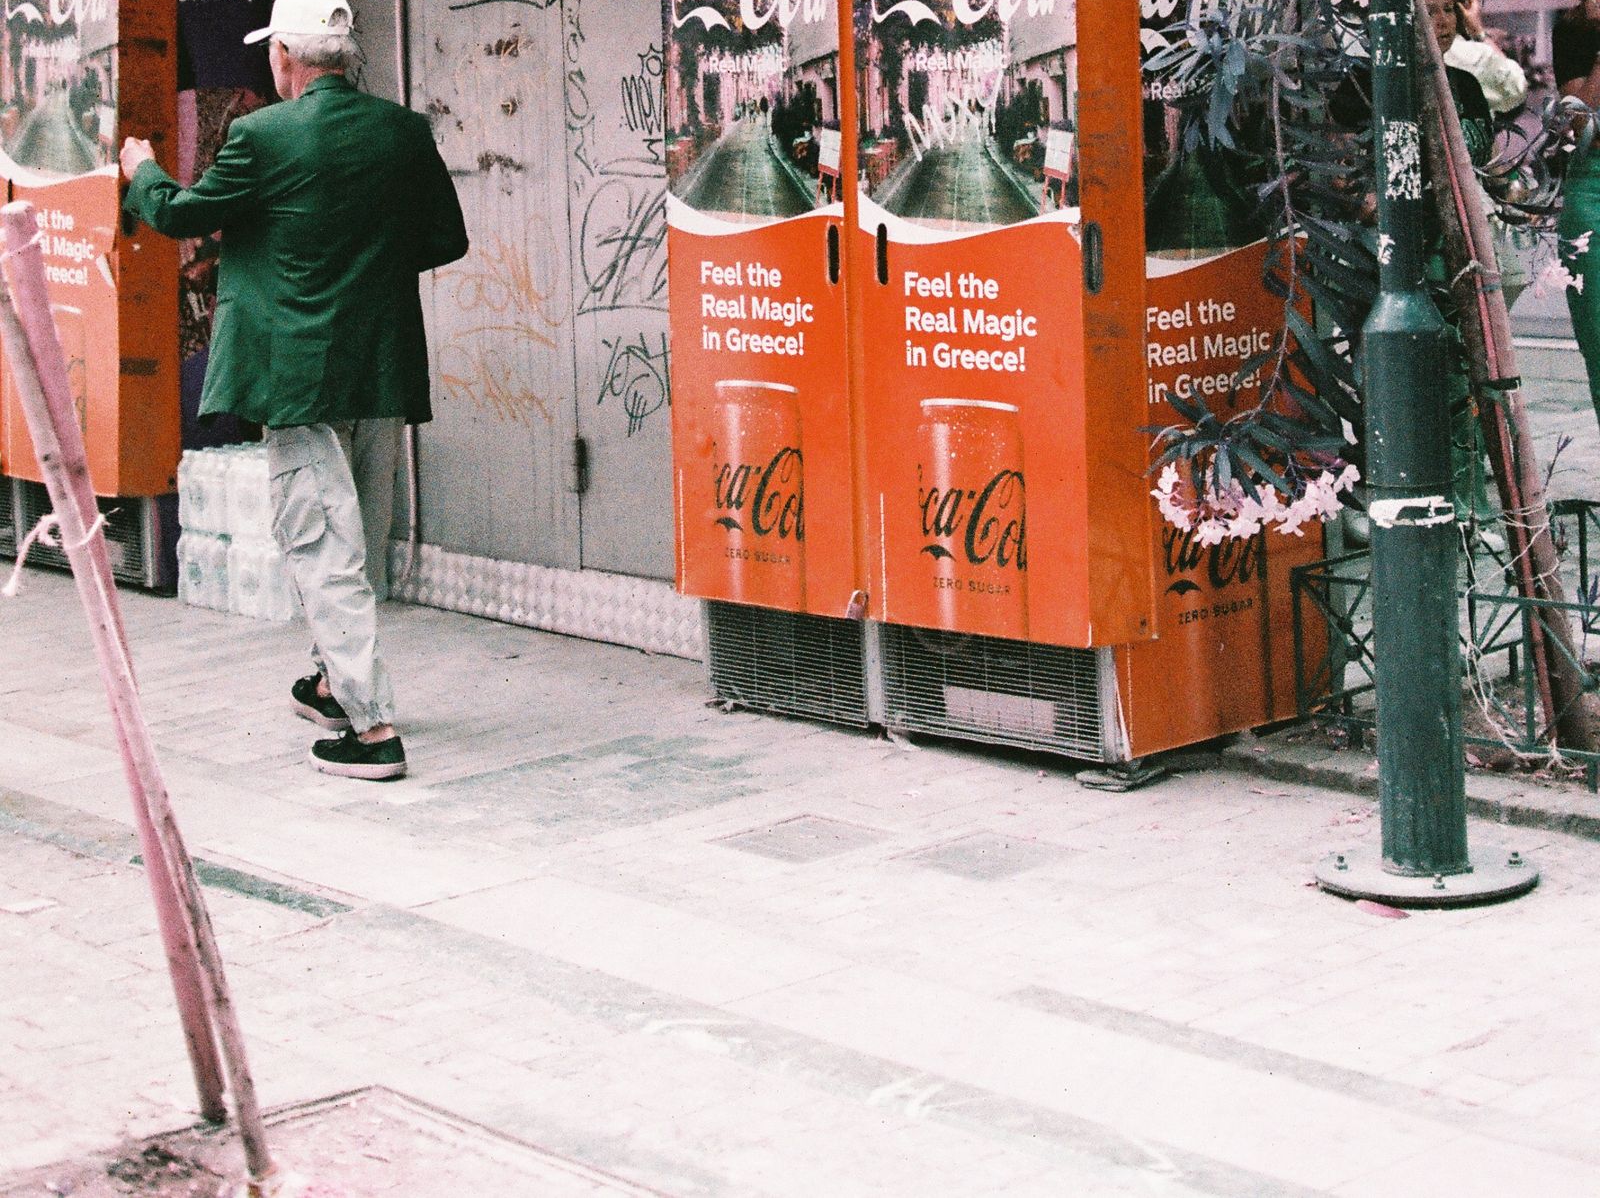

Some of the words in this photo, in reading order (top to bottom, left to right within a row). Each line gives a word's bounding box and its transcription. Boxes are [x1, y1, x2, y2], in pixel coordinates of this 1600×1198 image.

[52, 236, 95, 263] Magic
[45, 263, 88, 286] reece!
[700, 261, 743, 286] Feel
[746, 262, 782, 287] the
[904, 271, 953, 298] Feel
[957, 272, 999, 300] the
[701, 294, 747, 319] Real
[751, 296, 814, 327] Magic
[905, 306, 957, 333] Real
[963, 308, 1038, 341] Magic
[1146, 301, 1193, 333] Feel
[1197, 298, 1236, 325] the
[702, 324, 721, 351] in
[725, 327, 804, 356] Greece!
[1147, 336, 1198, 369] Real
[1203, 327, 1270, 360] Magic
[906, 339, 927, 367] in
[932, 342, 1026, 372] Greece!
[1148, 378, 1168, 404] in
[933, 576, 963, 591] ZERO
[1178, 608, 1209, 625] ZERO
[1213, 598, 1253, 617] SUGAR
